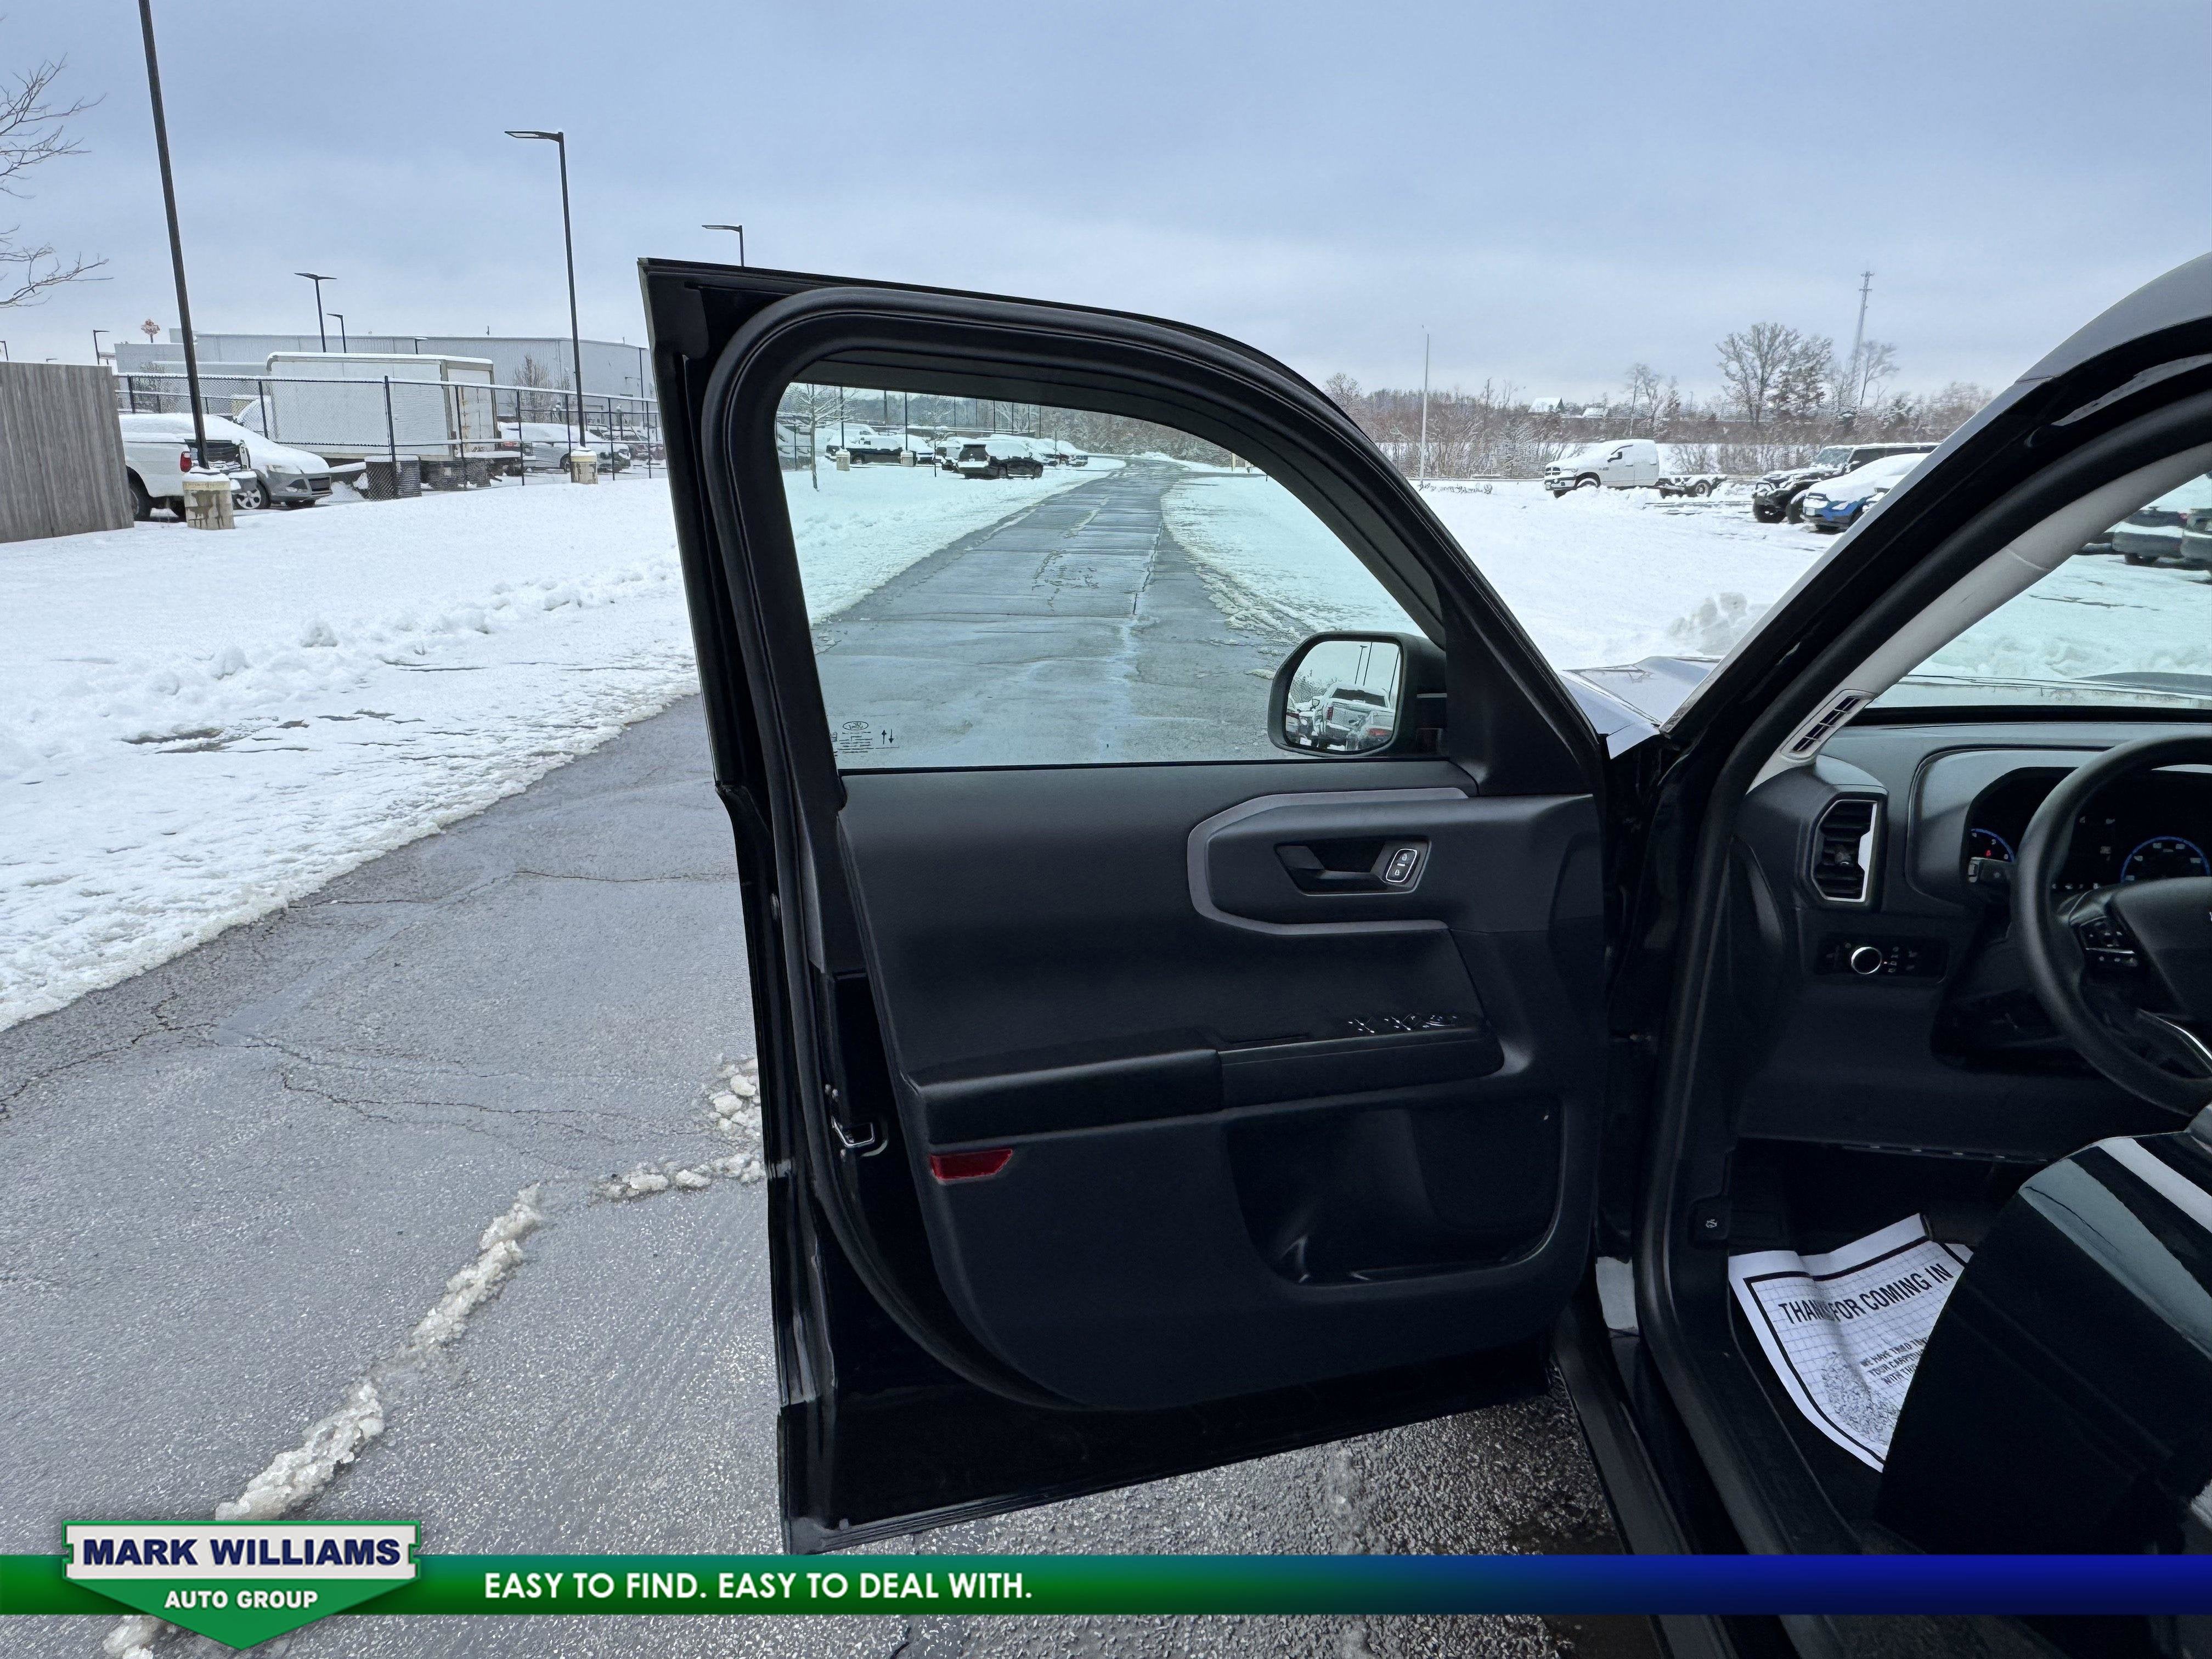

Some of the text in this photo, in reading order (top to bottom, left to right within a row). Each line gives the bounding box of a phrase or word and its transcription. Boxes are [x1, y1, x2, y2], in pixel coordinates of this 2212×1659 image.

[1828, 1299, 1866, 1322] FOR
[1859, 1273, 1932, 1310] COMING
[1925, 1263, 1954, 1284] IN
